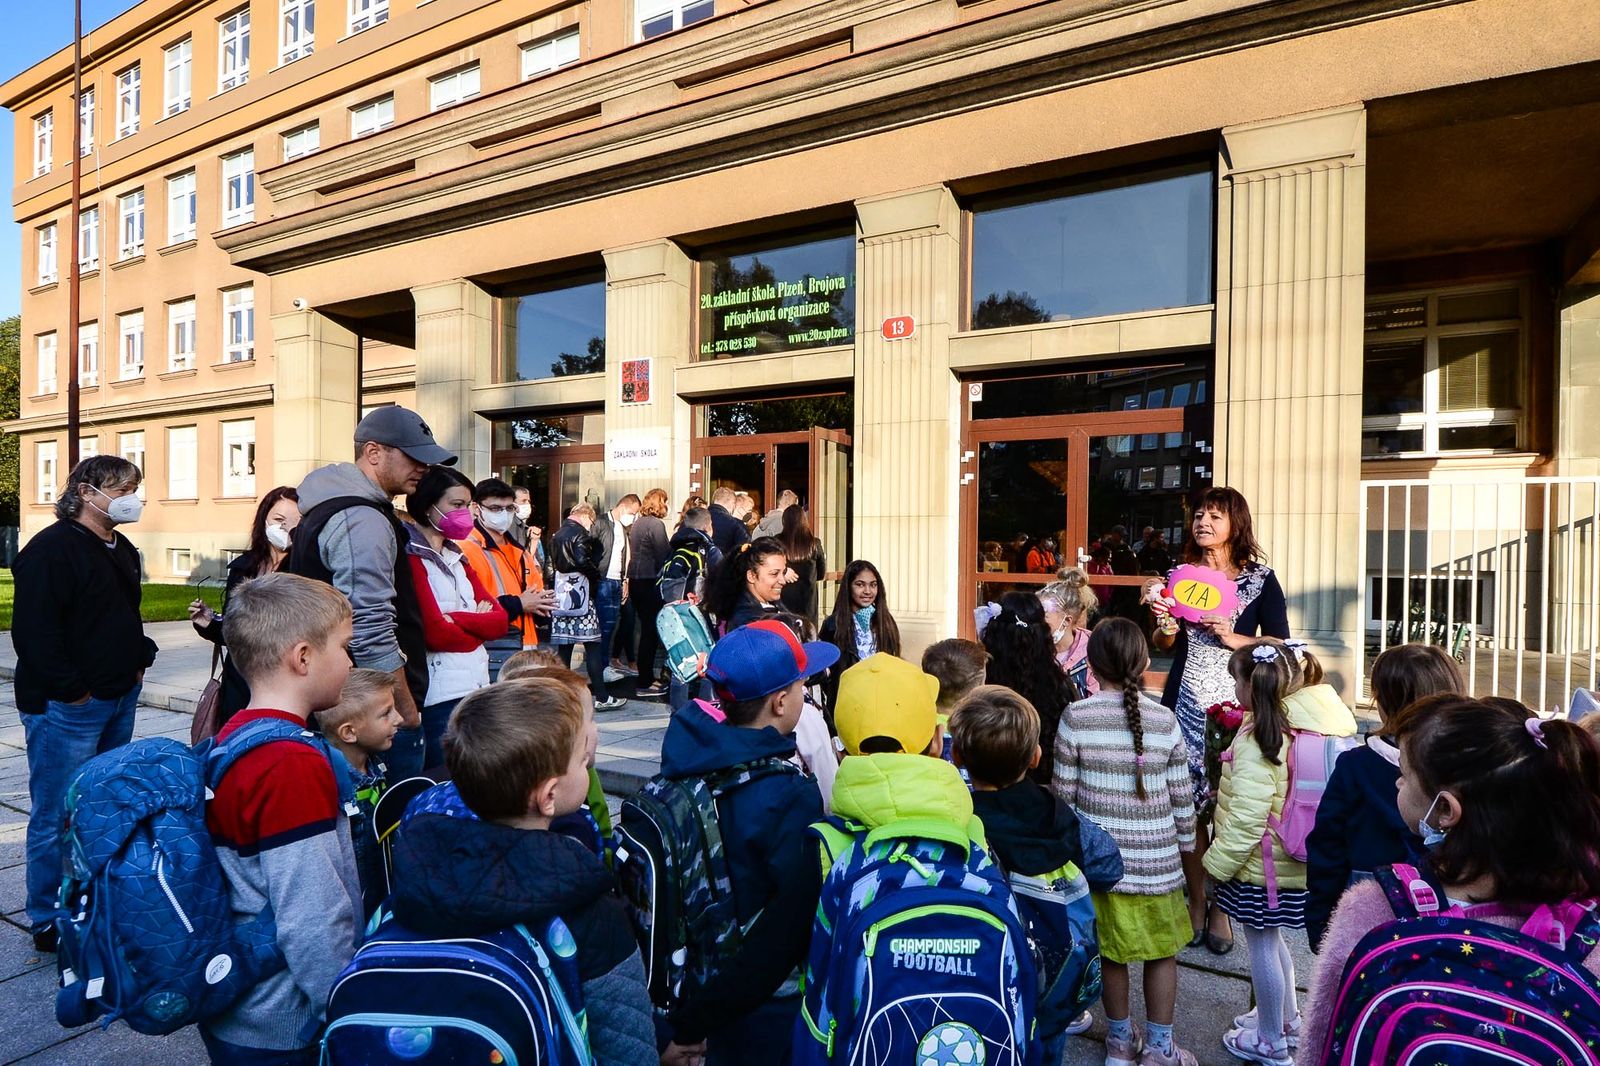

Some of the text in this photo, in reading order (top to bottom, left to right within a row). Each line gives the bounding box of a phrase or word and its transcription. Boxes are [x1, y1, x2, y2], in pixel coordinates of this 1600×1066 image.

[751, 284, 776, 302] škola
[777, 280, 806, 297] Plzeň,
[808, 275, 846, 296] Brojova
[724, 301, 830, 331] příspěvková organizace
[891, 320, 905, 335] 13
[715, 339, 728, 352] 378
[743, 336, 757, 349] 530
[1184, 582, 1209, 608] 1.A
[890, 938, 981, 954] CHAMPIONSHIP
[893, 951, 977, 977] FOOTBALL
